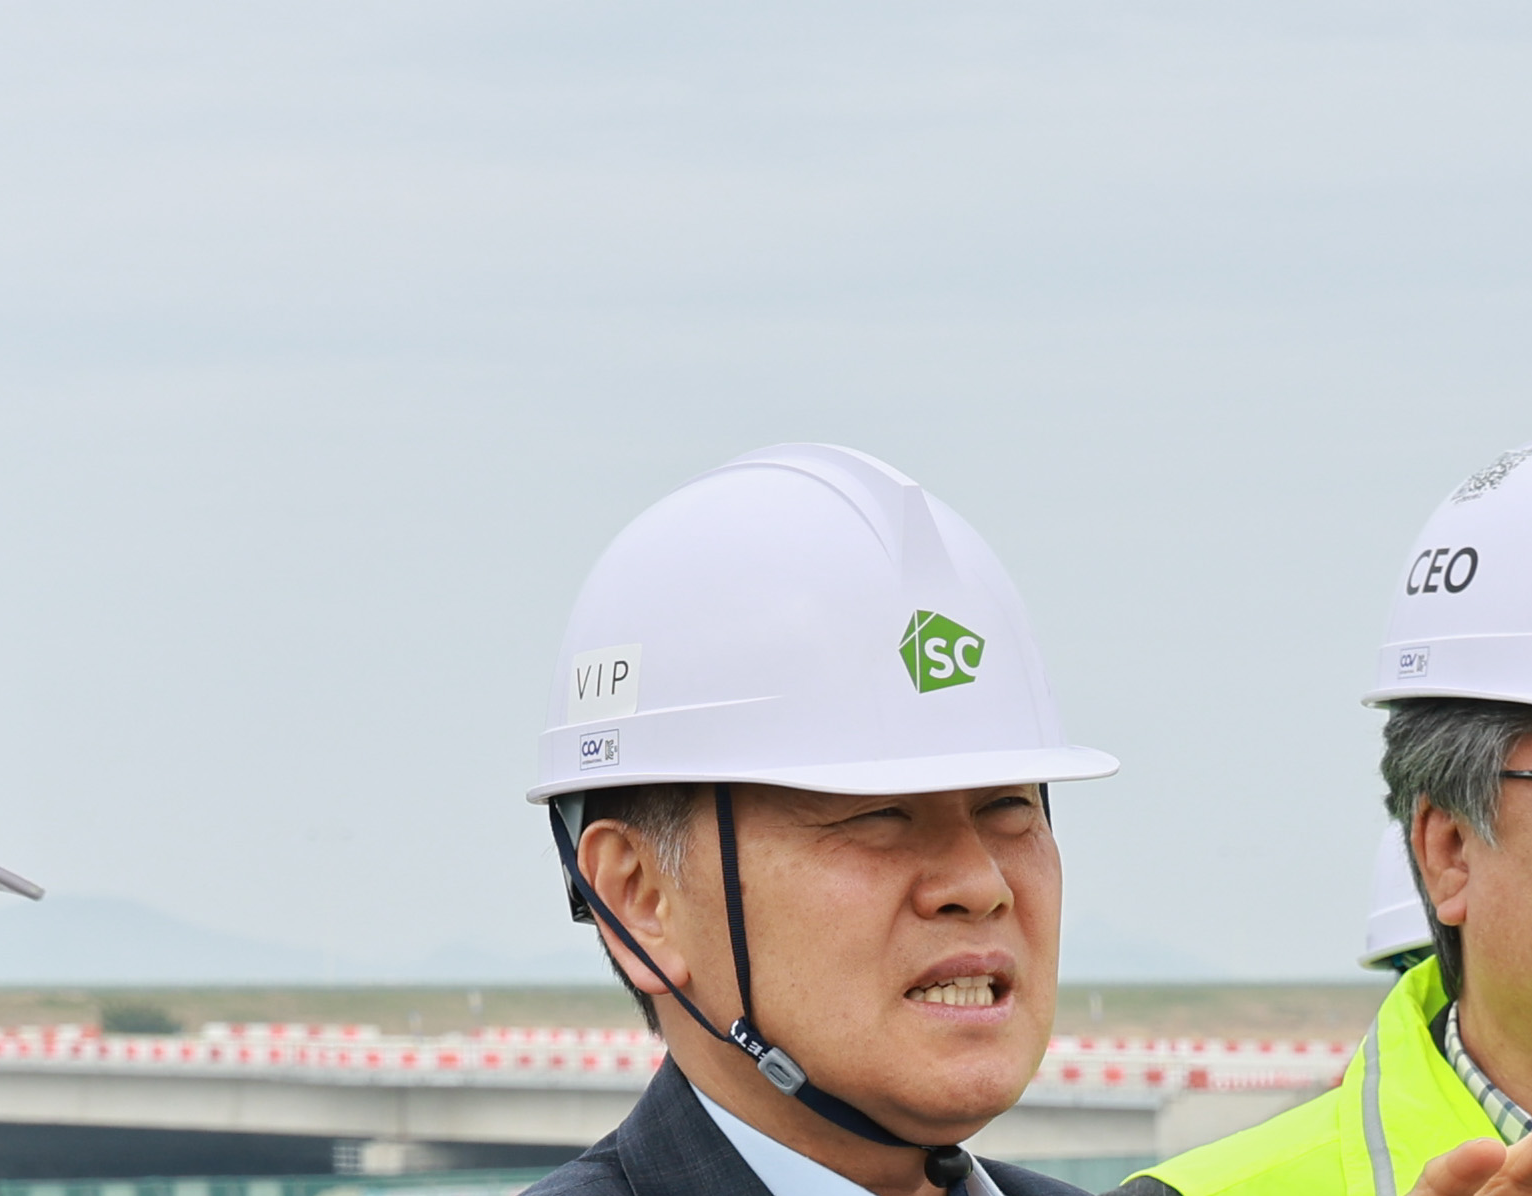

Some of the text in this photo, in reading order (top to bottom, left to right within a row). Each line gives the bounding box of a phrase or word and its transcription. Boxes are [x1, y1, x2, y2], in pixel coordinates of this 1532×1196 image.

[1405, 546, 1480, 596] CEO
[577, 660, 629, 700] VIP
[923, 636, 981, 680] SC
